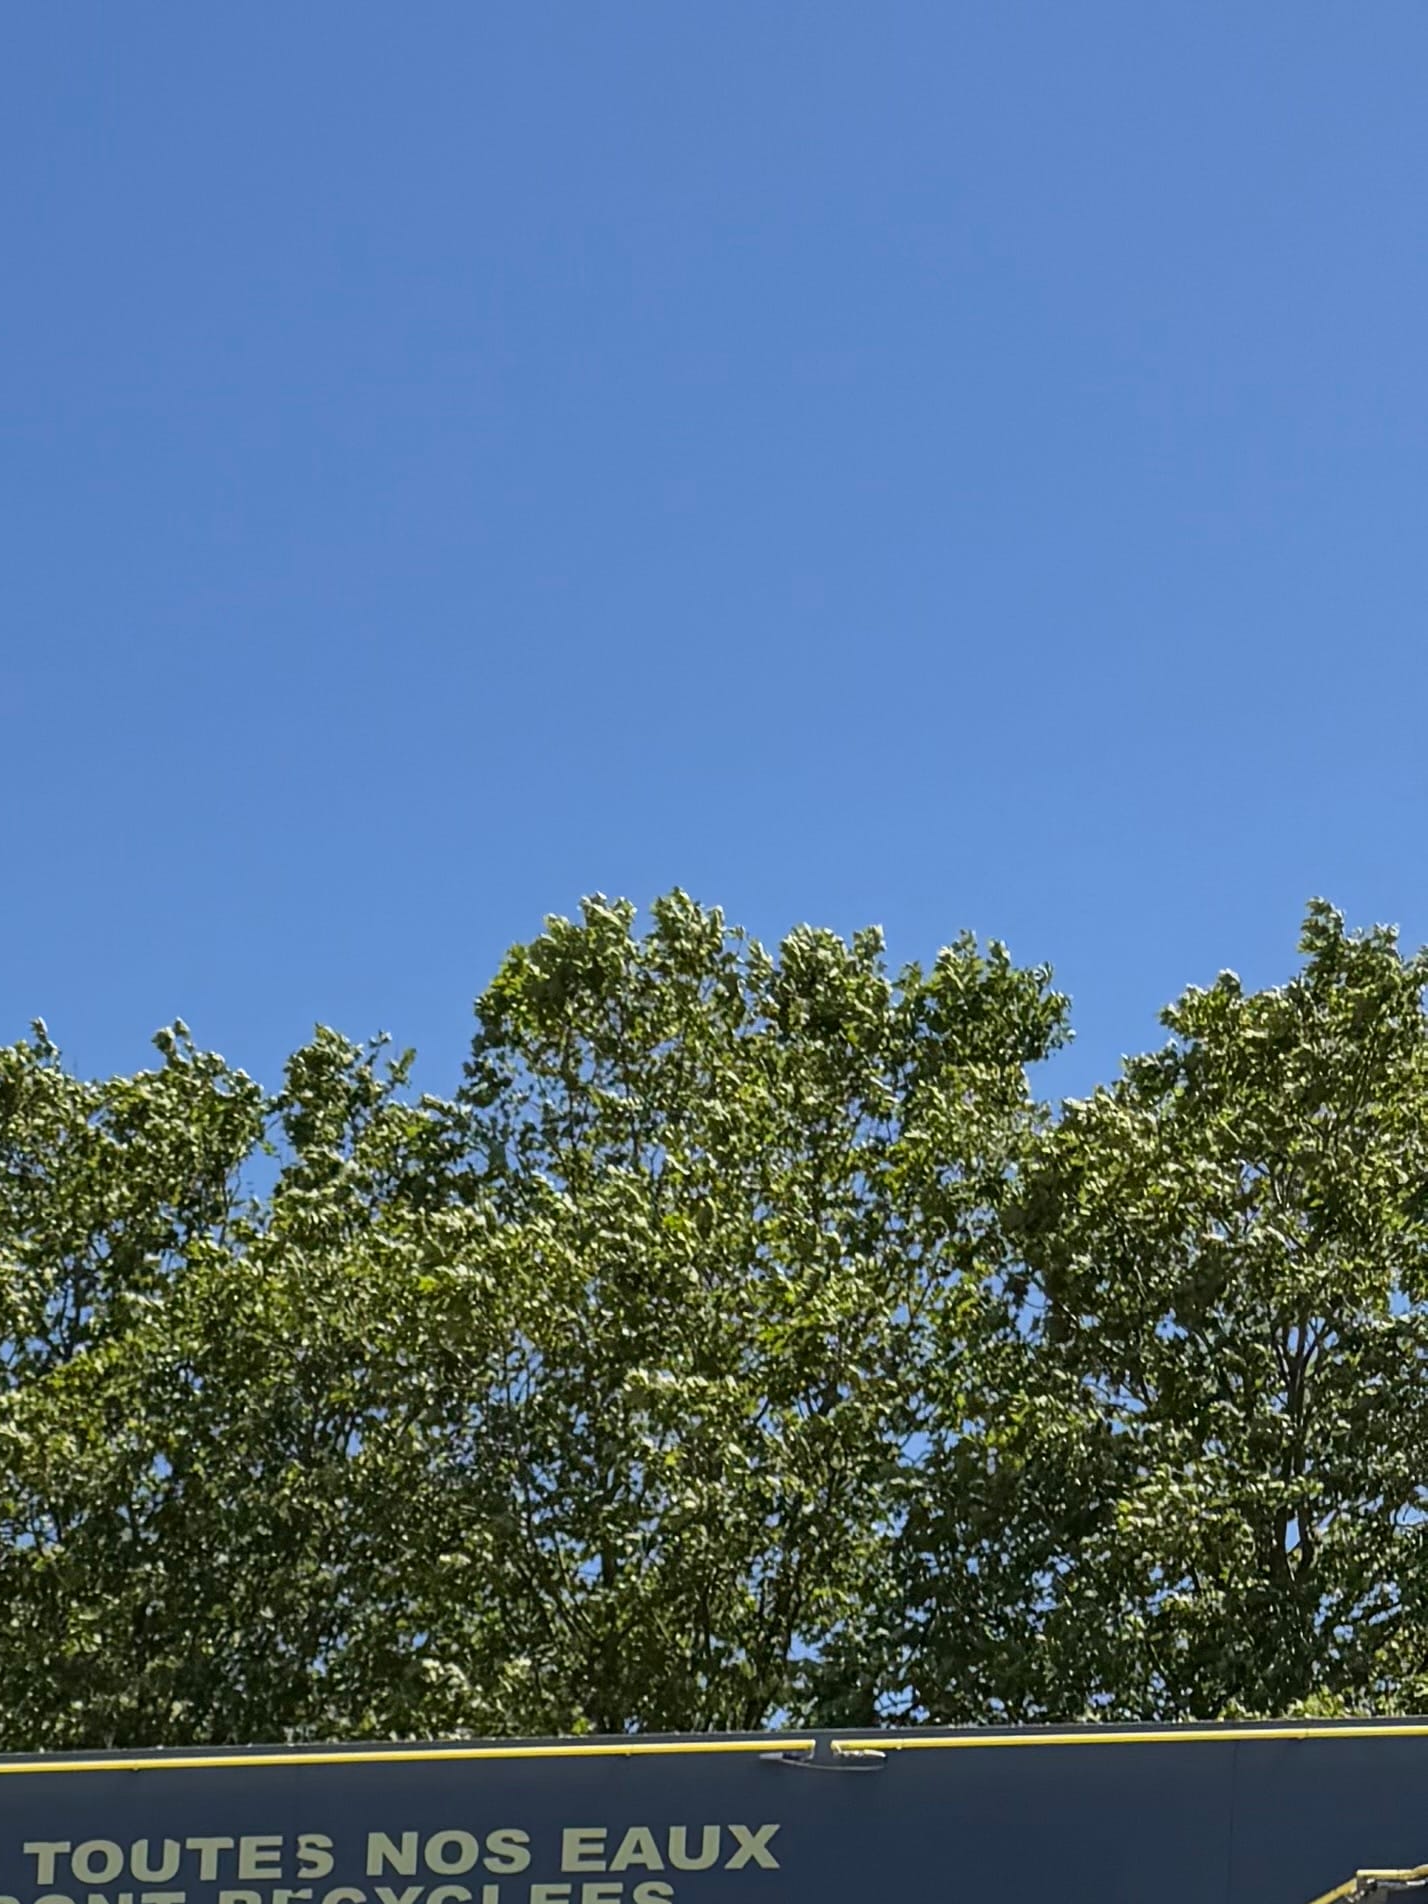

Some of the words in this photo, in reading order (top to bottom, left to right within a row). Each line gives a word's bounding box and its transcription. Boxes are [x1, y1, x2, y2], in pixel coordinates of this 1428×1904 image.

[23, 1833, 335, 1886] TOUTES
[366, 1828, 531, 1877] NOS
[561, 1823, 781, 1873] EAUX
